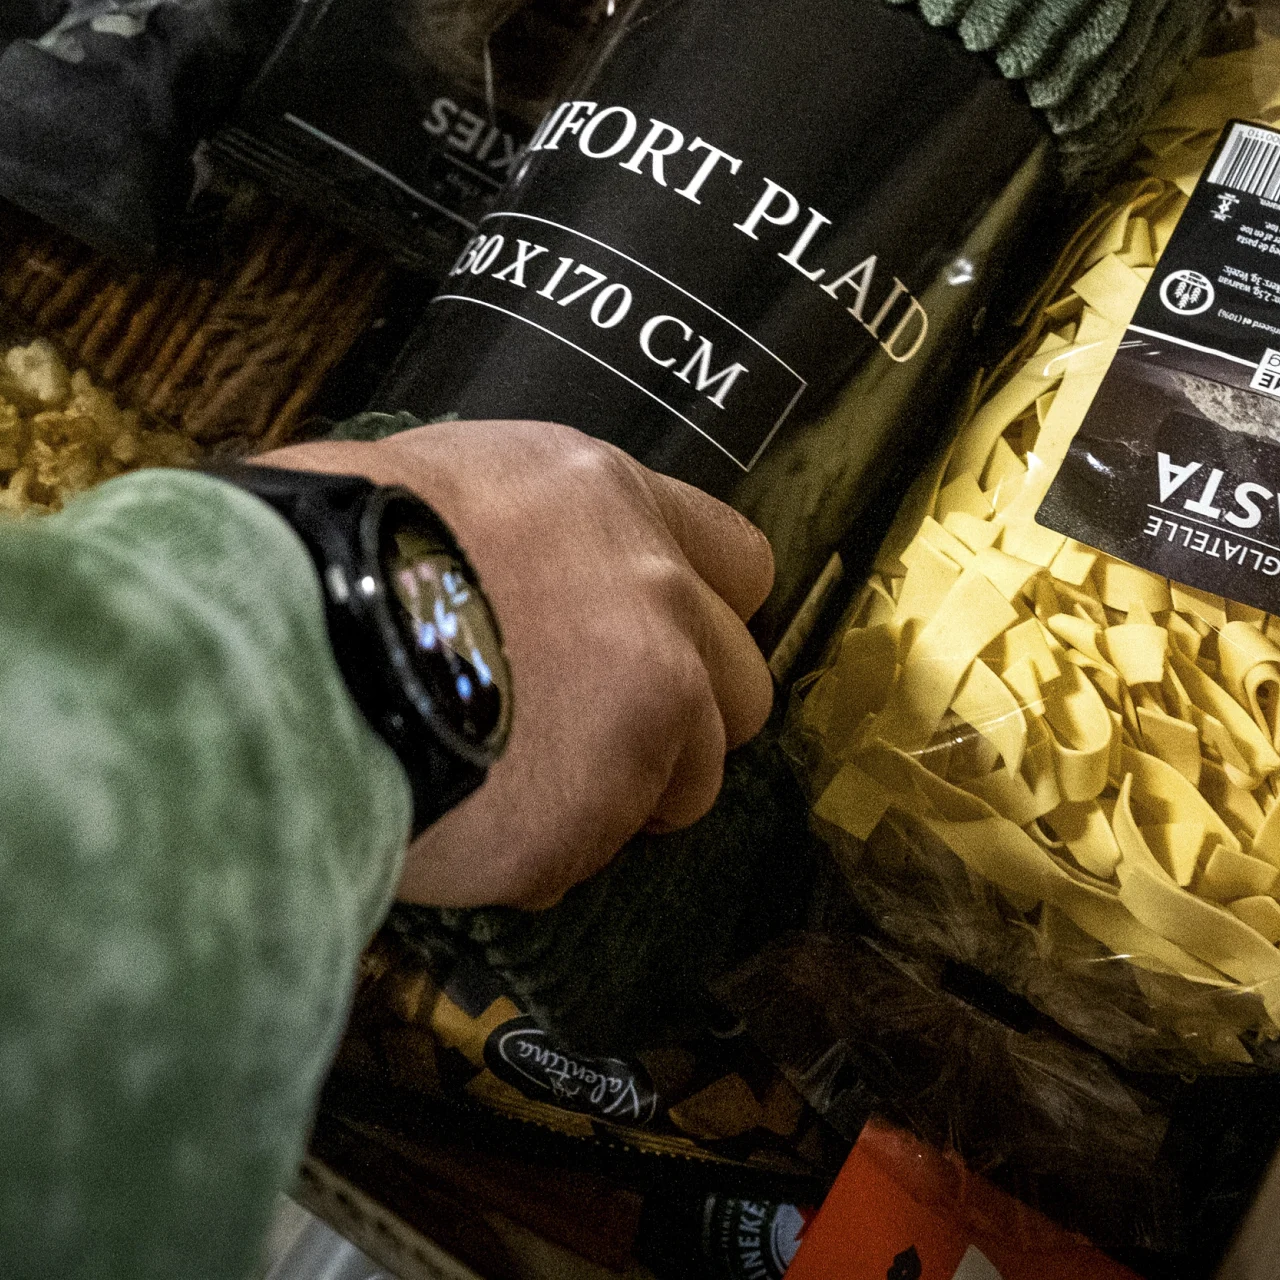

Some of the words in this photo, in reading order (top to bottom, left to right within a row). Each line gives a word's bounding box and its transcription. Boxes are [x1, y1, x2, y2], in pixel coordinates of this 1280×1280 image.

[1240, 225, 1253, 235] toe
[1265, 222, 1279, 232] toe.
[1236, 235, 1259, 247] pasta
[1263, 233, 1273, 241] af
[1258, 242, 1269, 252] de
[733, 177, 929, 363] PLAID
[1223, 265, 1248, 281] Vezels:
[1218, 276, 1251, 292] waarvan
[1218, 309, 1242, 323] (10%)
[491, 239, 550, 289] X
[535, 256, 633, 329] 170
[639, 314, 749, 410] CM
